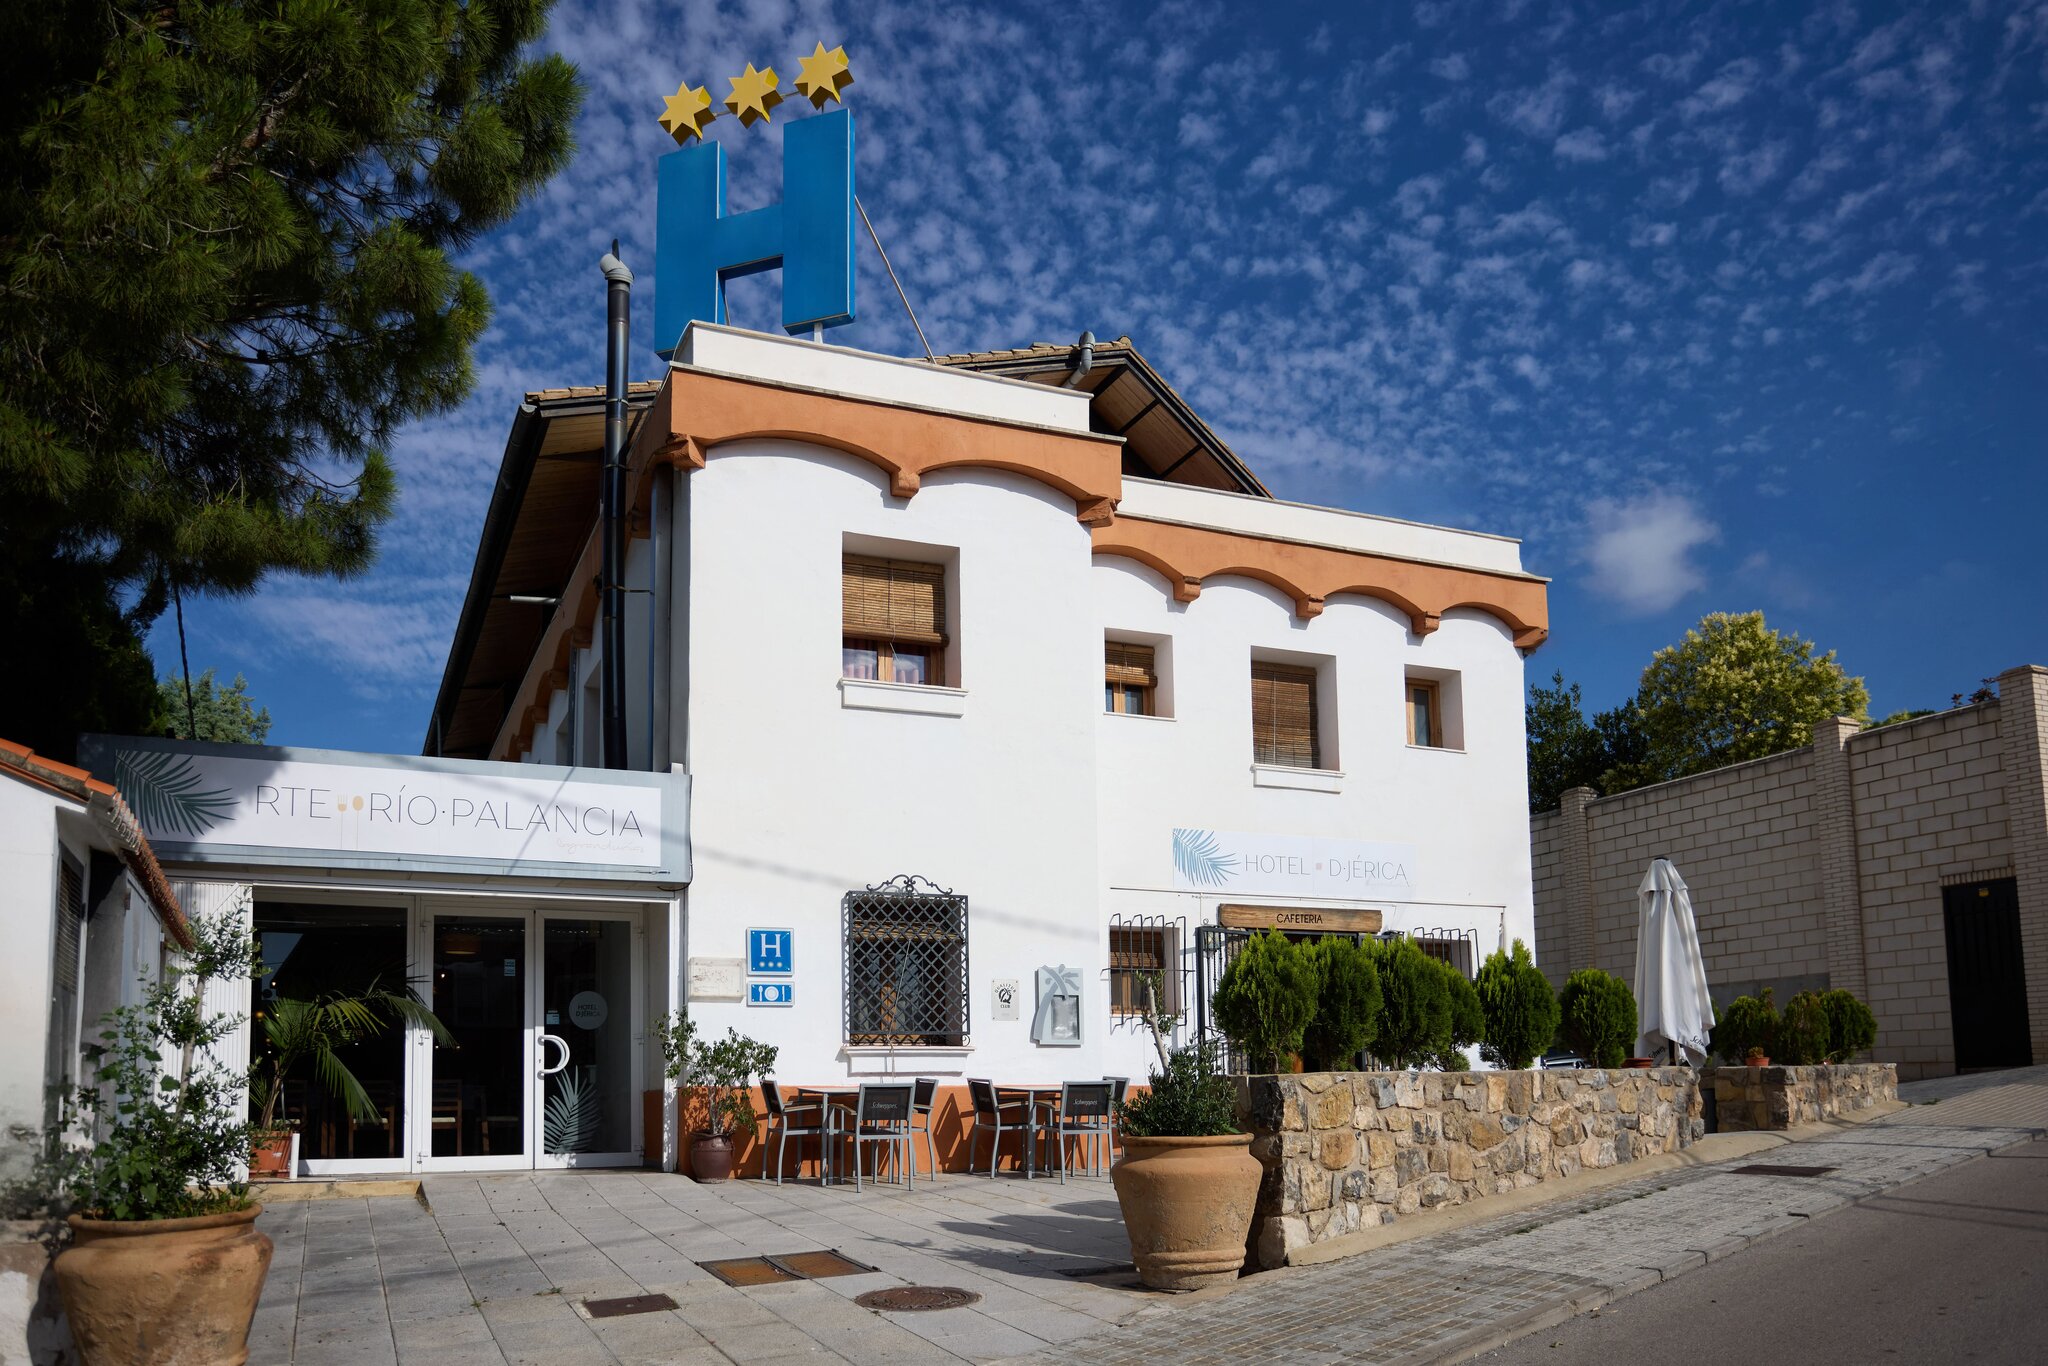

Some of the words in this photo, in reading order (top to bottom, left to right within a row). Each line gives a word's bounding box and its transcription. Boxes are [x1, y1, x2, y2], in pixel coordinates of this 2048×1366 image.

[655, 108, 855, 360] H
[256, 785, 332, 819] RTE
[1244, 854, 1311, 876] HOTEL
[1276, 913, 1323, 925] CAFETERIA
[760, 933, 782, 958] H
